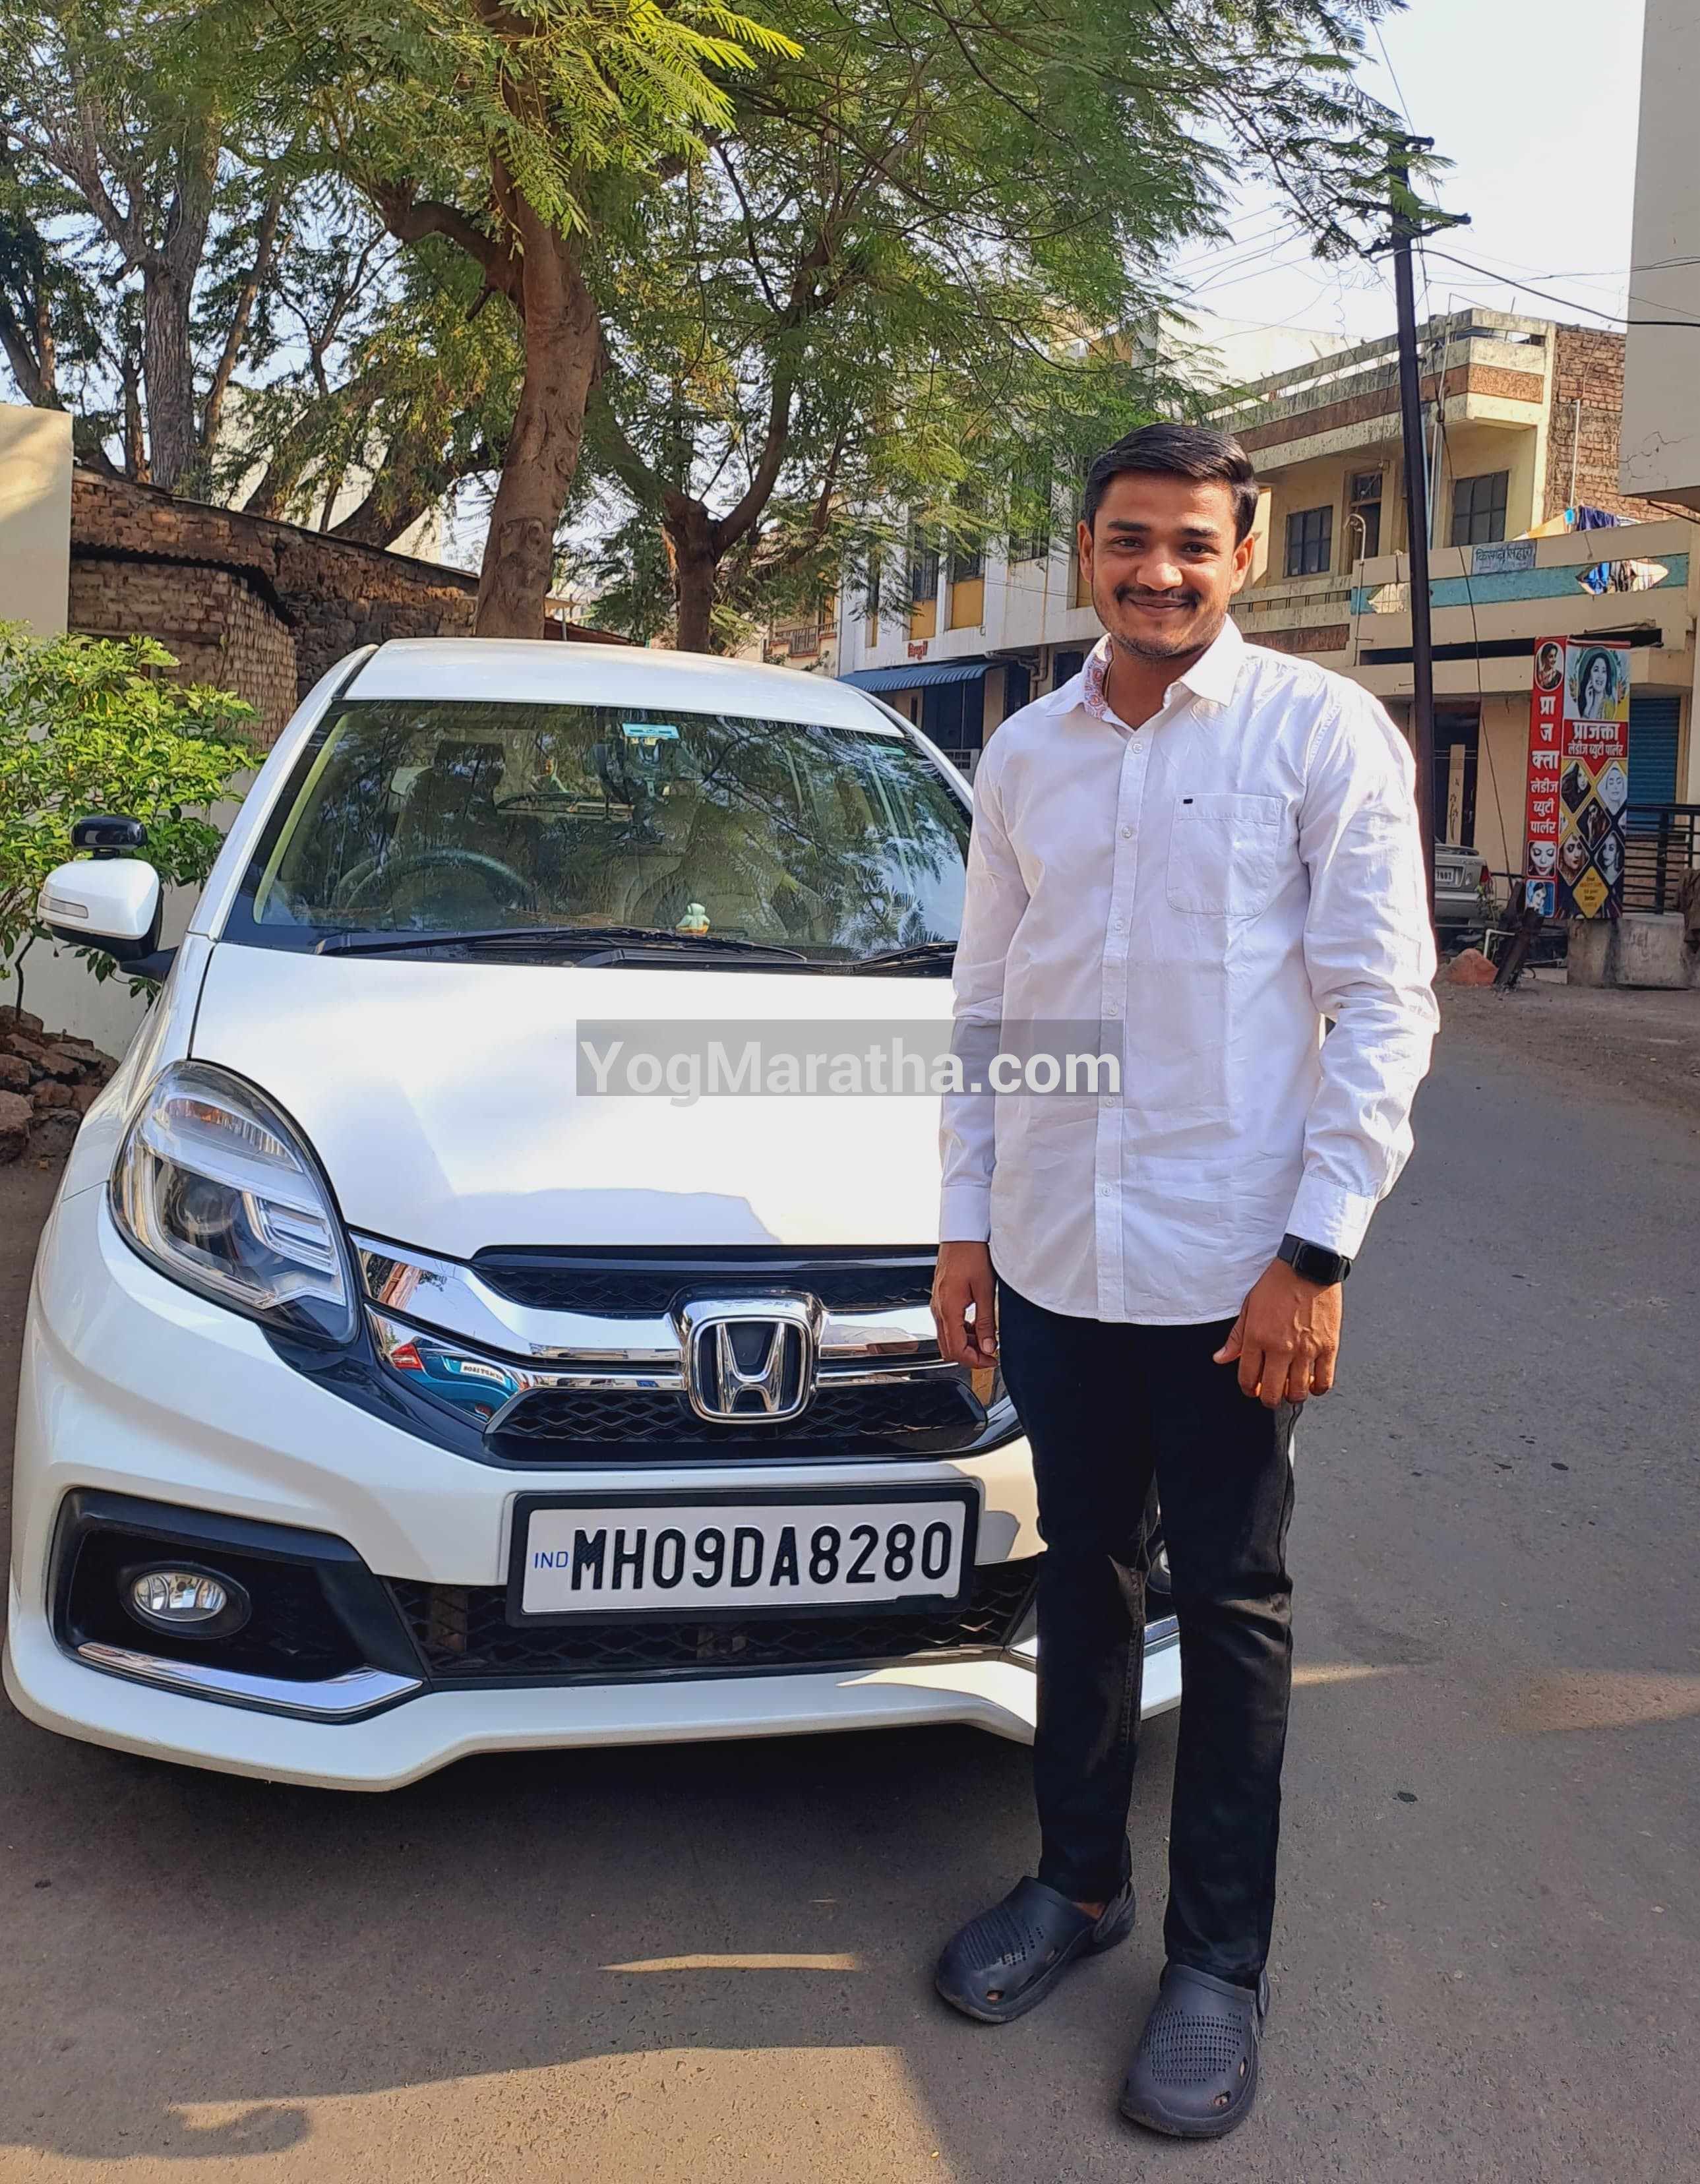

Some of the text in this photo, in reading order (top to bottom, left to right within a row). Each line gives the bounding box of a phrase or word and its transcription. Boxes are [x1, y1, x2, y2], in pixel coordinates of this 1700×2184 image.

[1572, 721, 1620, 741] प्राजक्ता
[1567, 741, 1589, 756] लेडीज
[1605, 741, 1624, 756] पार्लर
[1530, 777, 1559, 793] लेडीज
[1530, 818, 1557, 834] पार्लर
[533, 1521, 951, 1591] IND MH09DA8280
